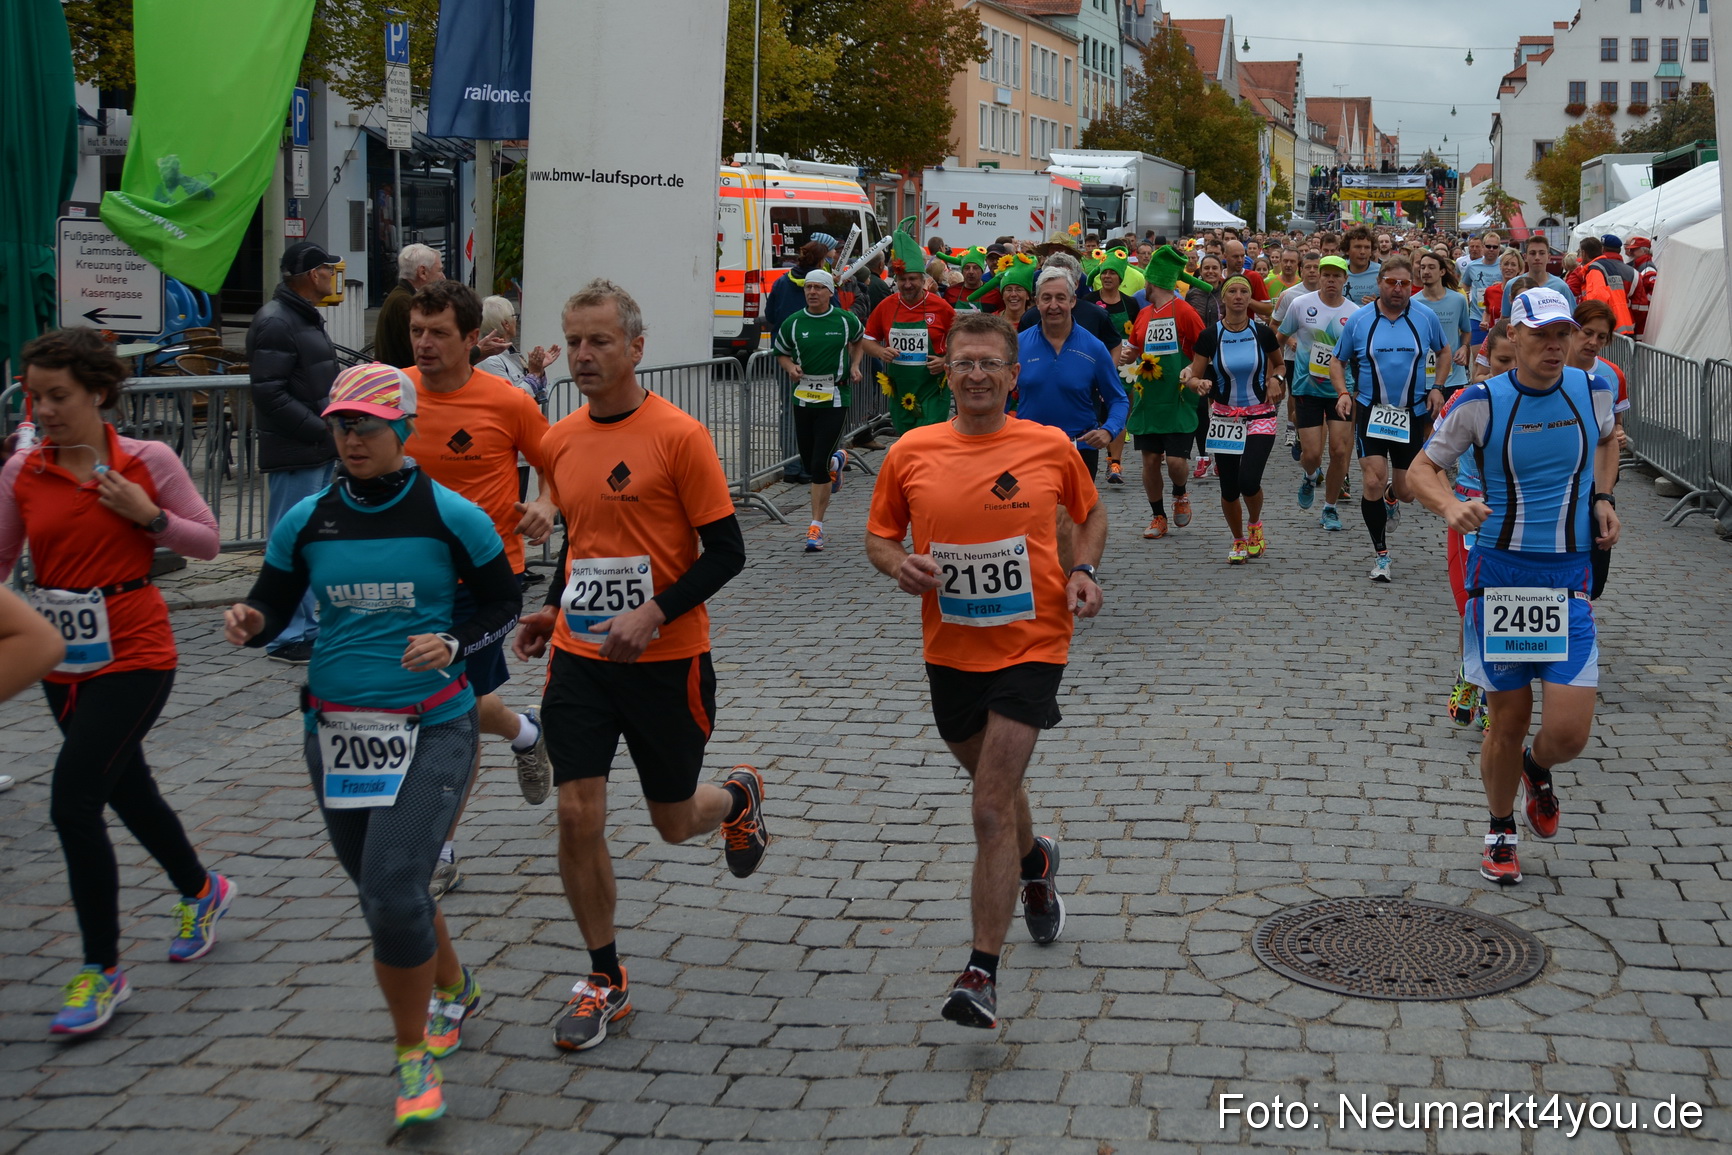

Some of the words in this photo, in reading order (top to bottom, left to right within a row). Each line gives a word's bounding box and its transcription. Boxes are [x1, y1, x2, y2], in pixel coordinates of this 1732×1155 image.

[391, 21, 403, 56] P
[296, 95, 306, 139] P
[333, 165, 342, 184] 3
[530, 167, 684, 188] www.bmw-laufsport.de
[1367, 191, 1397, 199] START
[978, 202, 1019, 212] Bayerisches
[1196, 220, 1224, 228] Laufsport
[63, 230, 115, 243] Fußgänger
[76, 259, 122, 272] Kreuzung
[125, 260, 147, 270] über
[96, 274, 128, 284] Untere
[81, 287, 143, 300] Kaserngasse
[1147, 327, 1173, 342] 2423
[892, 337, 924, 352] 2084
[1374, 410, 1407, 429] 2022
[1208, 423, 1243, 440] 3073
[600, 493, 639, 502] FliesenEichl
[984, 501, 1030, 511] FliesenEichl
[932, 550, 962, 561] PARTL
[964, 549, 1011, 561] Neumarkt
[572, 567, 592, 576] PARTL
[593, 566, 634, 576] Neumarkt
[942, 560, 1023, 595] 2136
[326, 581, 415, 601] HUBER
[570, 578, 645, 612] 2255
[350, 600, 411, 608] TECHNOLOGY
[1486, 594, 1513, 602] PARTL
[1515, 594, 1554, 602] Neumarkt
[967, 602, 1002, 615] Franz
[1493, 605, 1561, 633] 2495
[1505, 639, 1548, 651] Michael
[320, 720, 349, 731] PARTL
[350, 722, 400, 731] Neumarkt
[331, 734, 407, 770] 2099
[341, 778, 387, 794] Franziska
